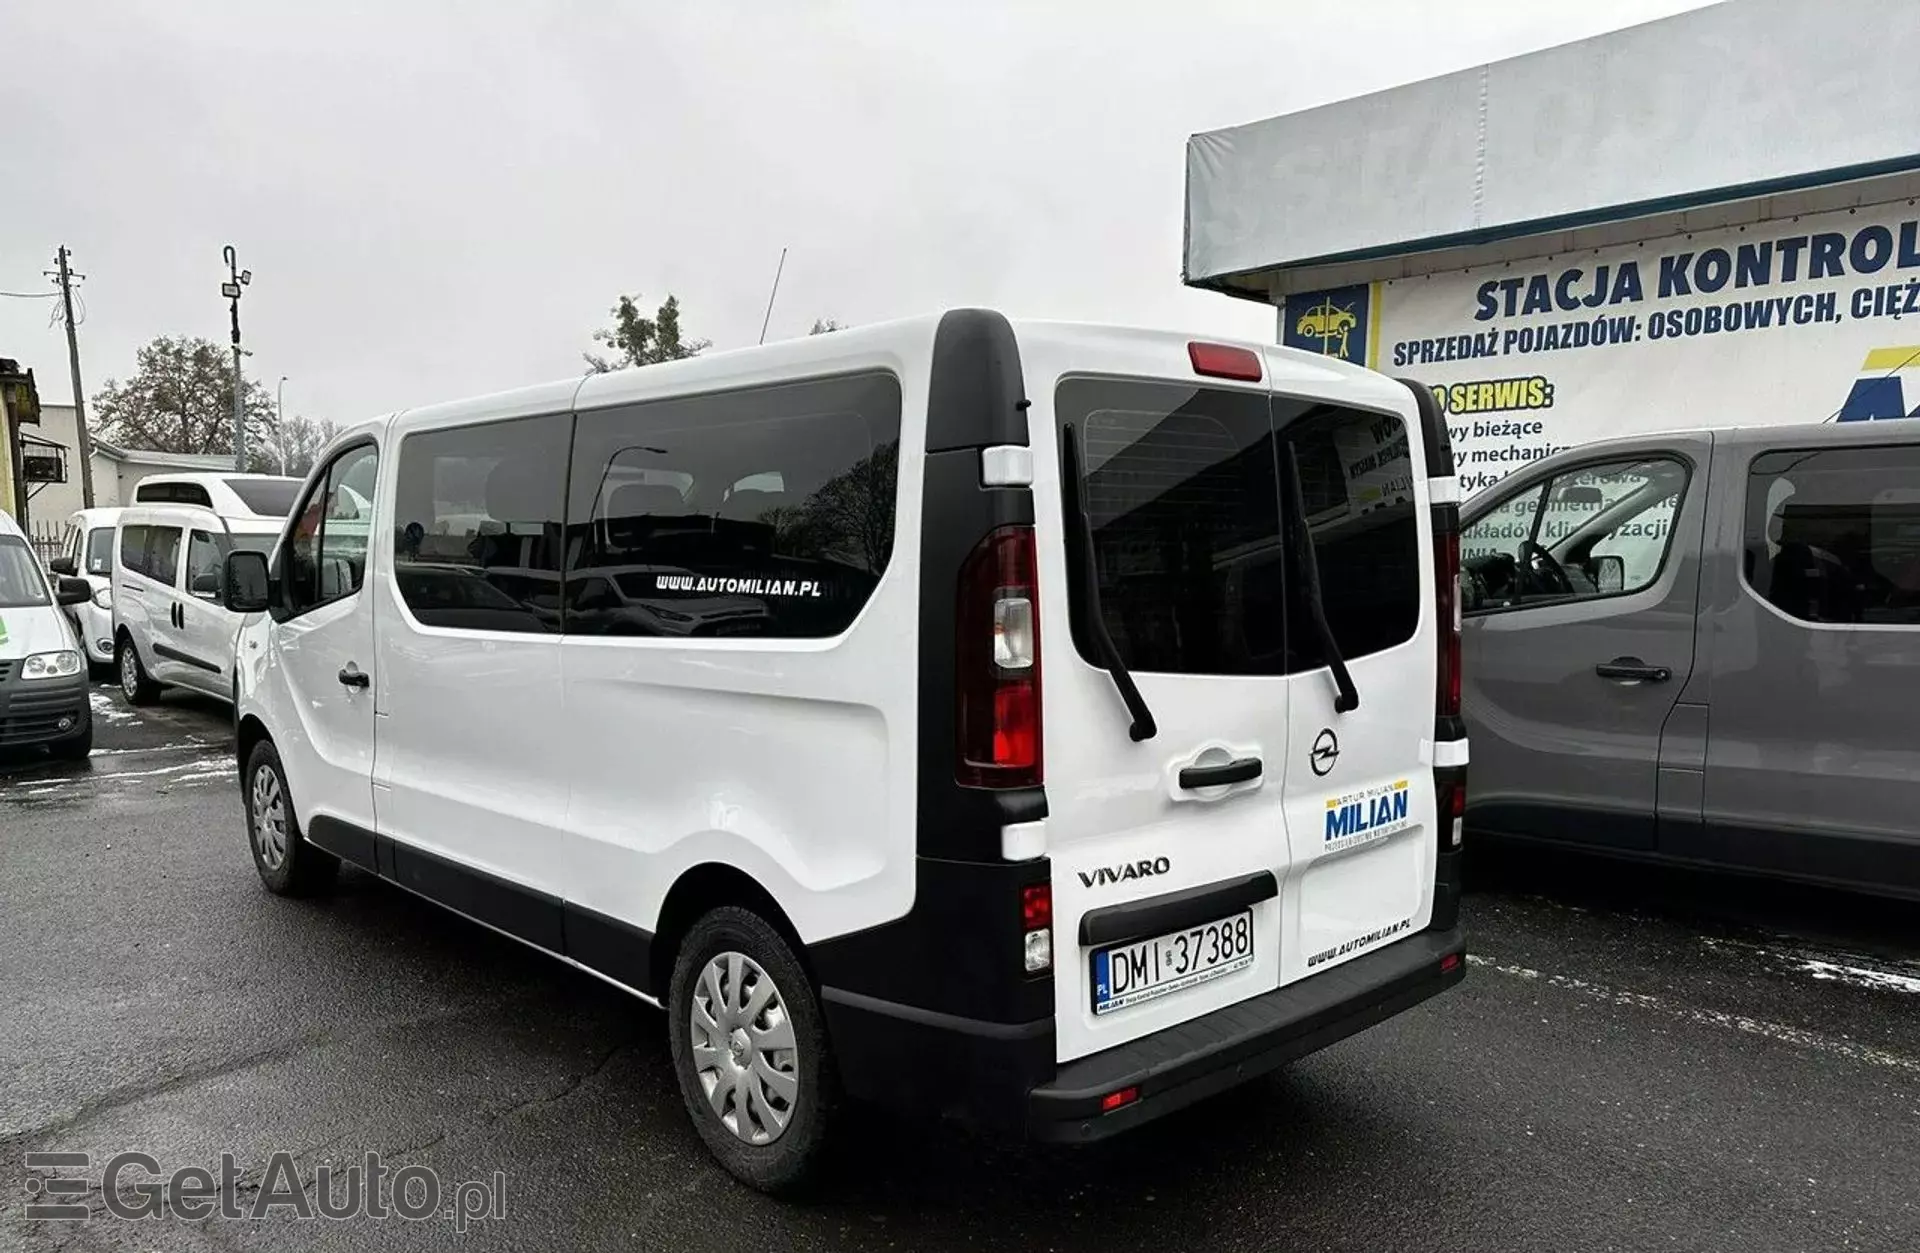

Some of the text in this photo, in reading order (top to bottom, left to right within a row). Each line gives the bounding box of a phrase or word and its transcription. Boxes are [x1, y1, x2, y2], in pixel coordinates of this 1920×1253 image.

[1474, 221, 1920, 321] STACJA KONTROL
[1393, 327, 1499, 366] SPRZEDAŻ
[1503, 314, 1642, 355] POJAZDÓW:
[1647, 292, 1842, 340] OSOBOWYCH,
[1449, 376, 1554, 415] SERWIS:
[1473, 420, 1542, 439] bieżące
[656, 576, 821, 597] WWW.AUTOMILIAN.PL
[1325, 789, 1408, 841] MILIAN
[1336, 792, 1365, 805] ARTUR
[1077, 856, 1170, 888] VIVARO
[1111, 942, 1160, 995] DMI
[1174, 917, 1248, 974] 37388
[1307, 918, 1411, 967] WWW.AUTOMILIAN.PL
[1097, 984, 1108, 996] PL
